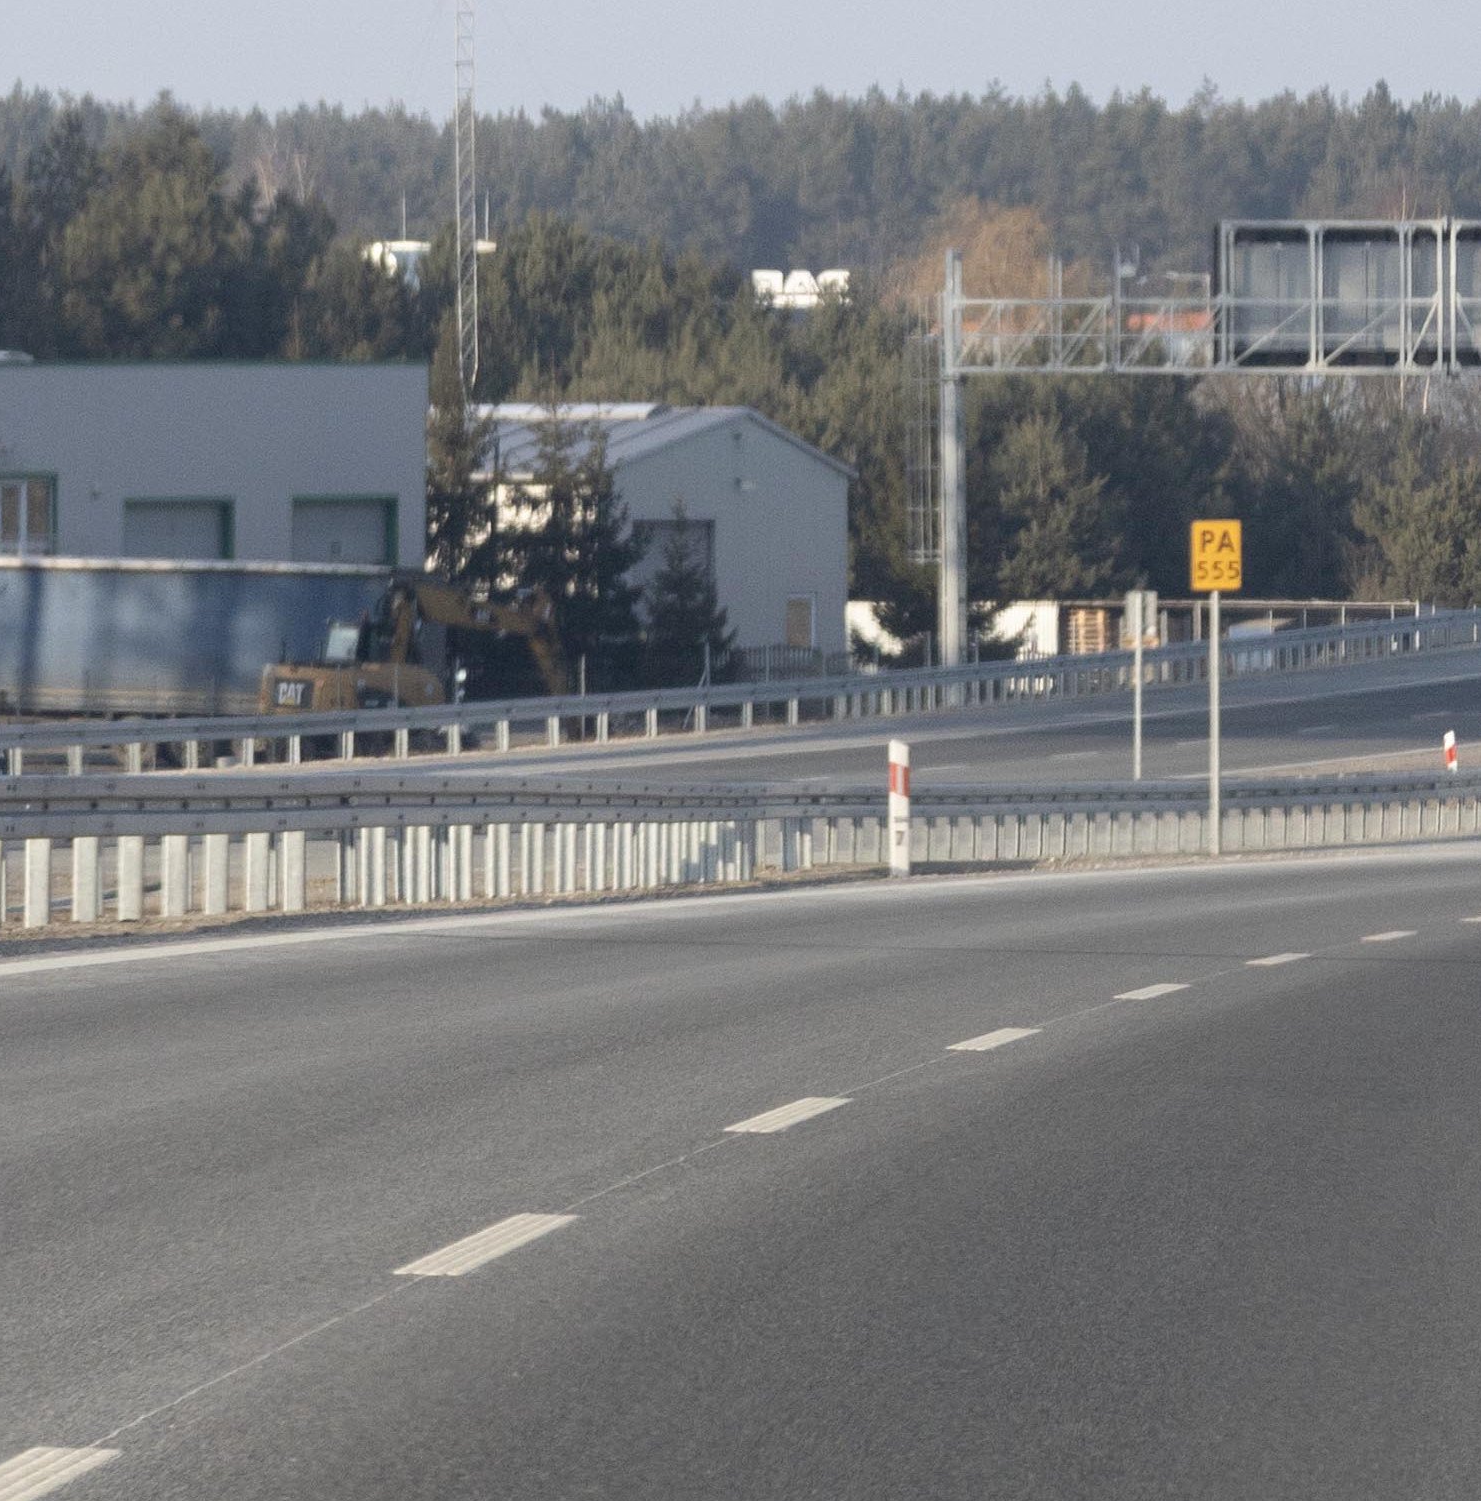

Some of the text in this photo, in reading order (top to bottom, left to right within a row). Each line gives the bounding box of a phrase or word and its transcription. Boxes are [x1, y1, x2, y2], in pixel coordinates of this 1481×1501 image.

[1200, 529, 1236, 554] PA
[1196, 559, 1240, 581] 555
[277, 682, 305, 705] CAT
